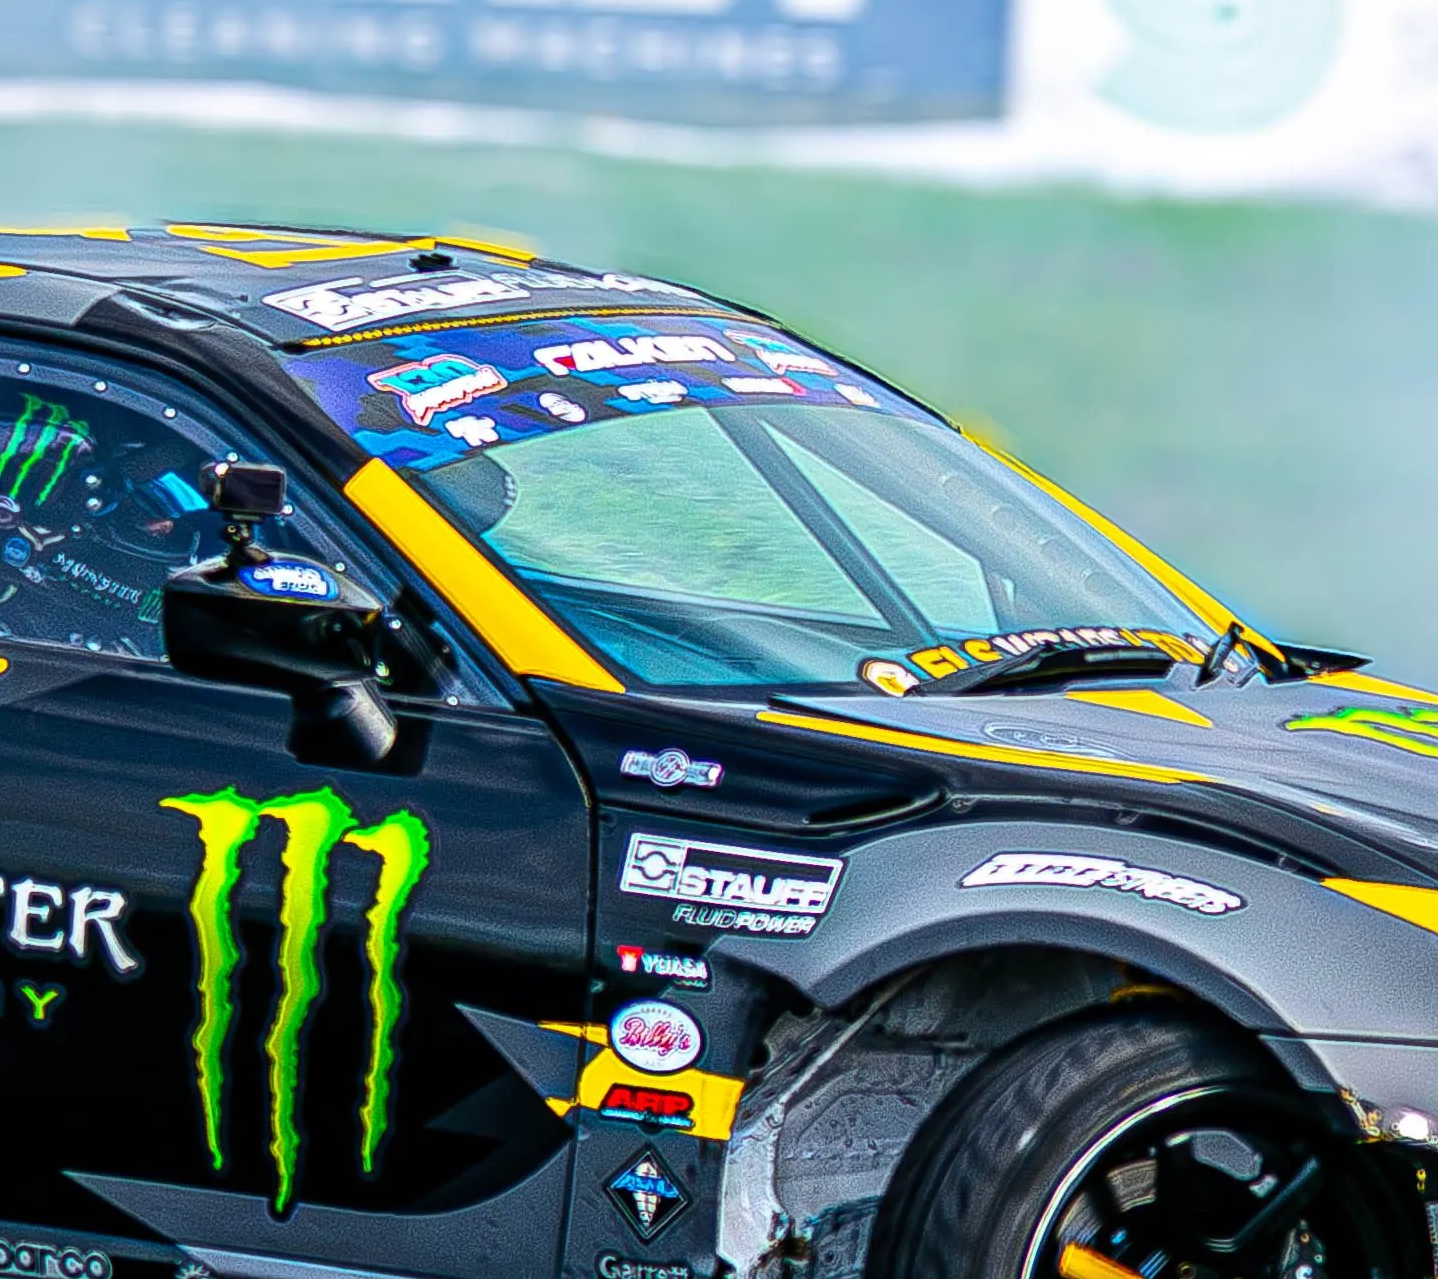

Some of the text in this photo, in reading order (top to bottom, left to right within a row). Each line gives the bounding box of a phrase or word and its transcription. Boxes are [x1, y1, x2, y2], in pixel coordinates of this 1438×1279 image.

[680, 866, 831, 906] STAUFF
[642, 953, 708, 979] YUASA
[607, 1088, 692, 1115] ARP
